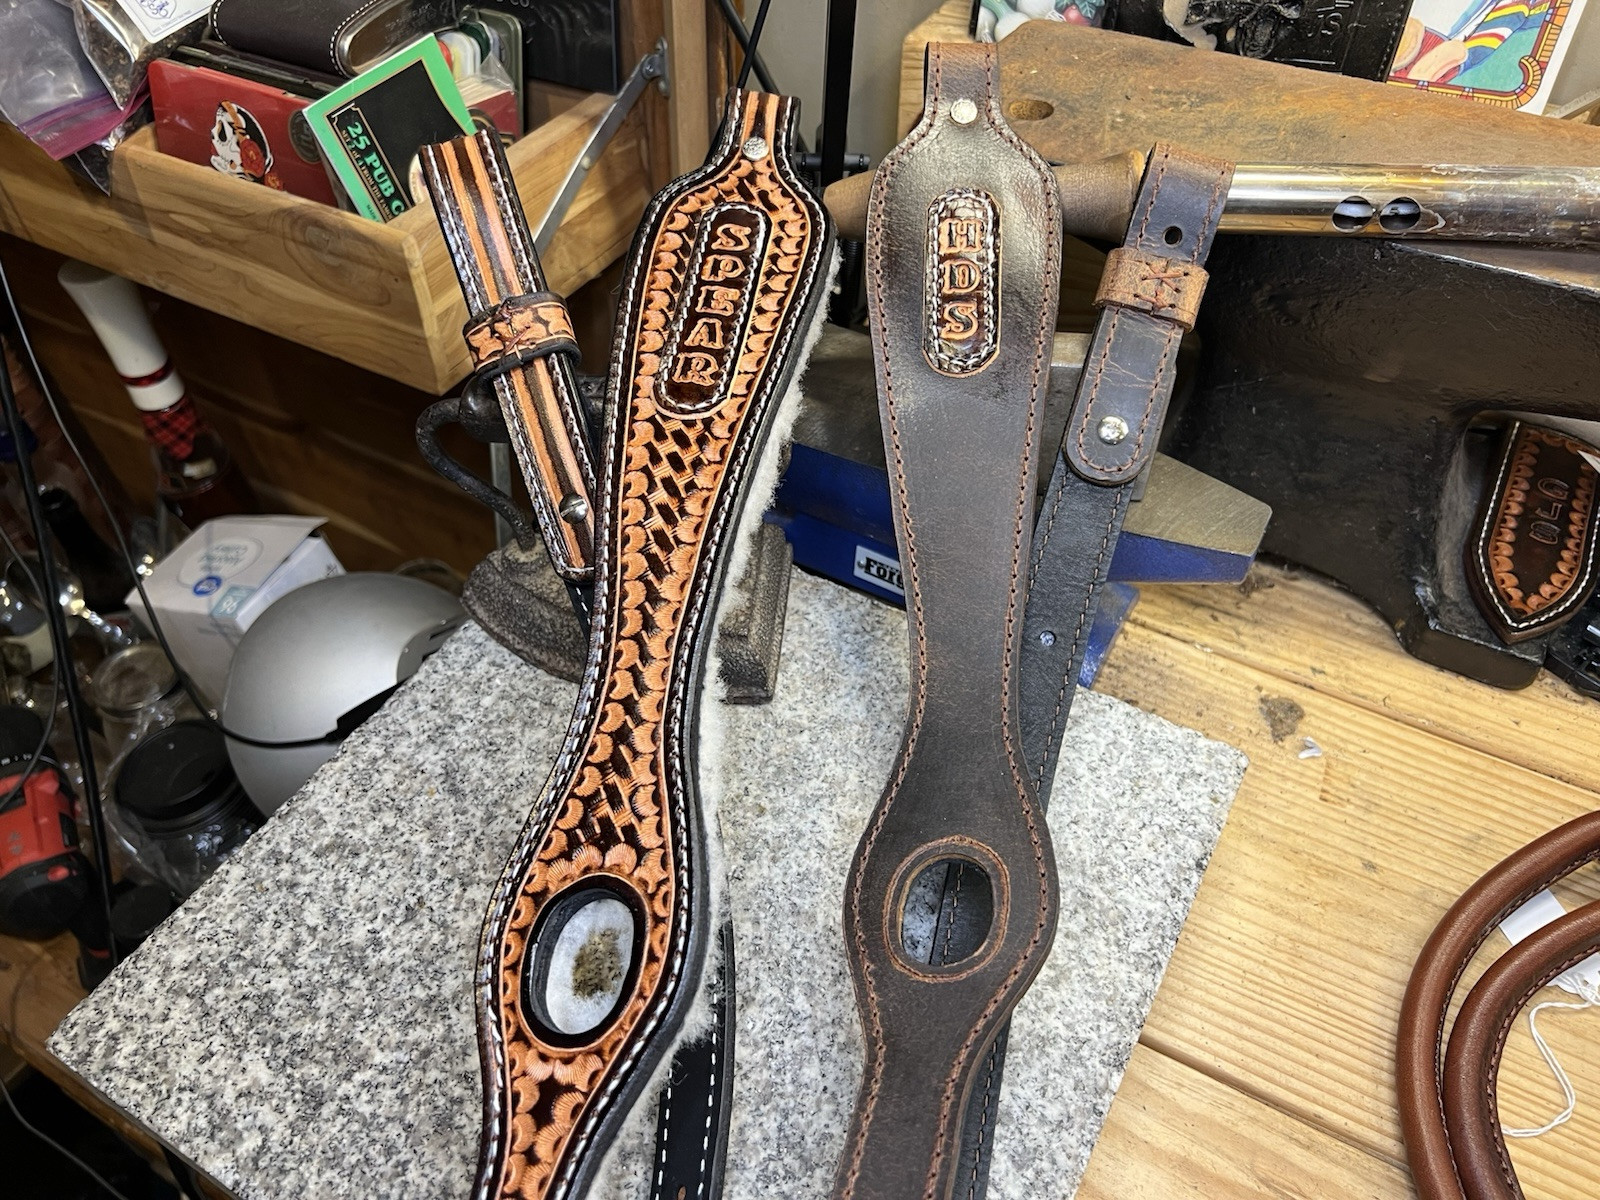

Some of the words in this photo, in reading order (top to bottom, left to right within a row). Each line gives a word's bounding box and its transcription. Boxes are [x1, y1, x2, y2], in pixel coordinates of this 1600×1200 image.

[347, 121, 371, 150] 25
[364, 151, 396, 198] PUB
[672, 223, 751, 386] SPEAR
[939, 218, 983, 340] HDS
